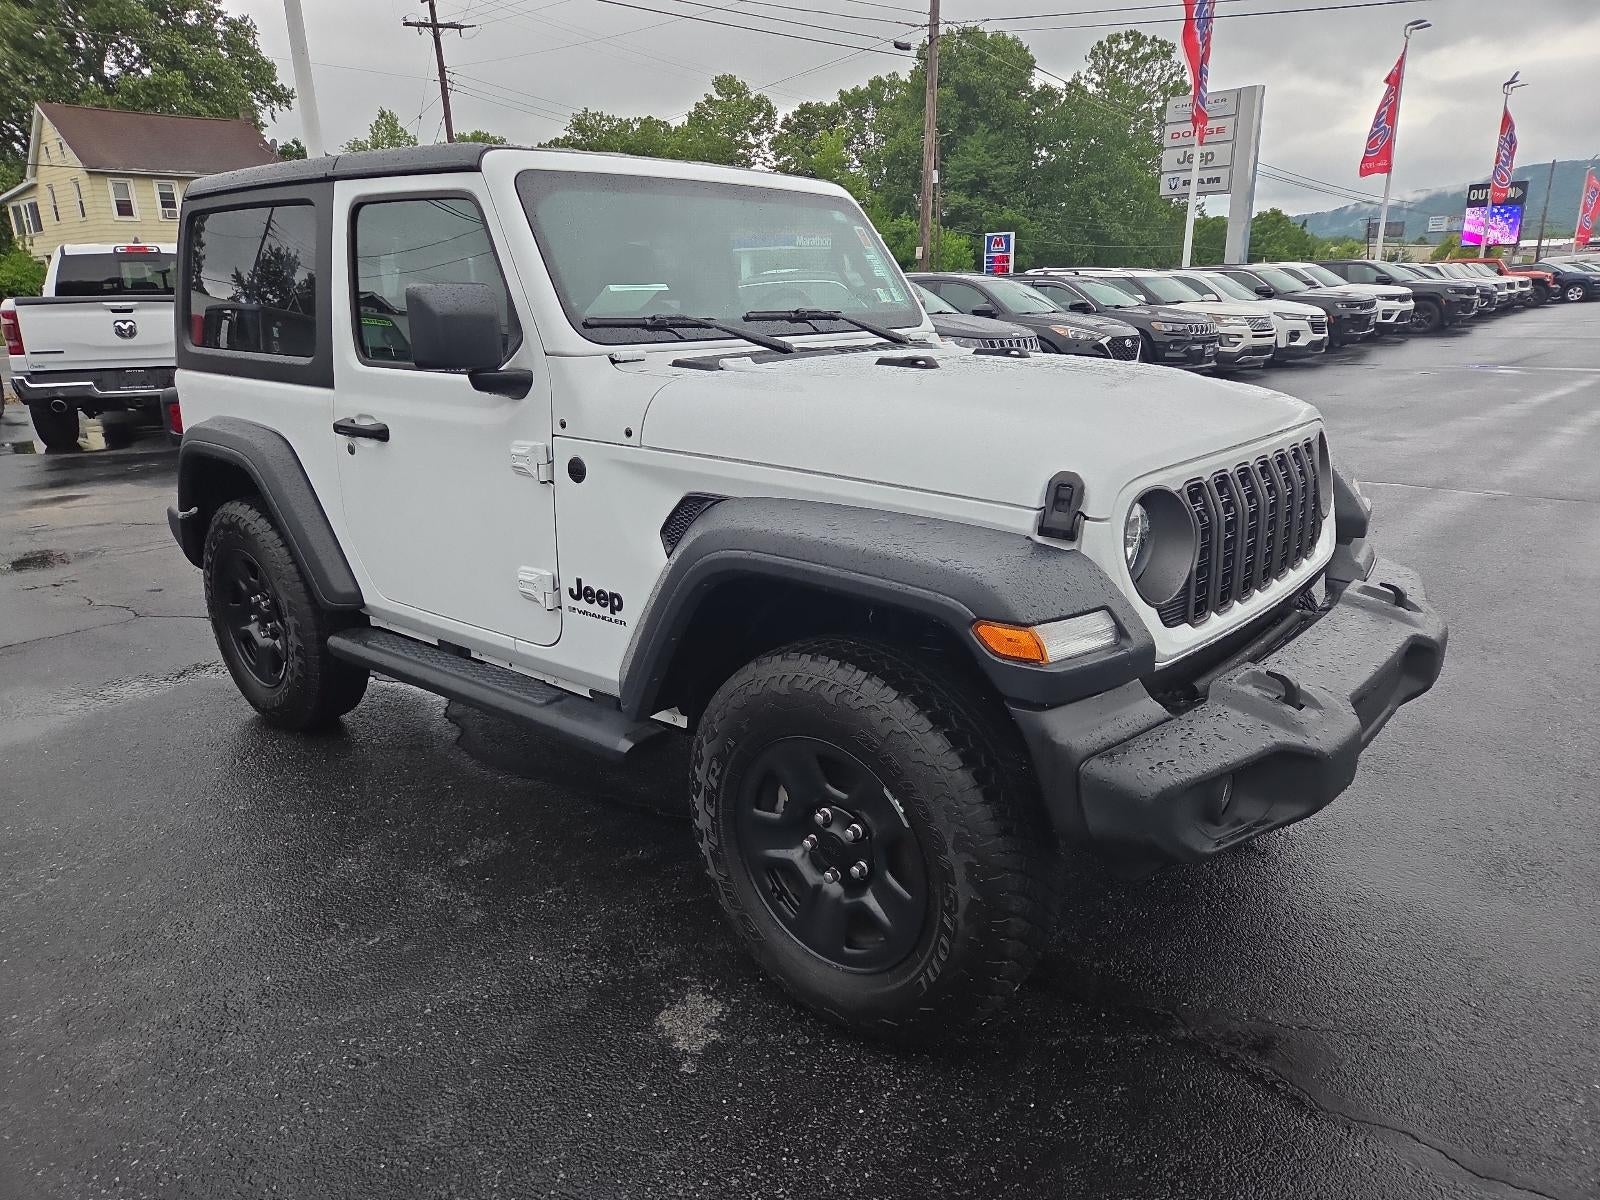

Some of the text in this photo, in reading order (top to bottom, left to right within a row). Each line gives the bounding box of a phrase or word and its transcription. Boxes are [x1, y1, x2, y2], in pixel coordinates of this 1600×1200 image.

[1174, 97, 1228, 109] CHRLER
[1176, 150, 1215, 165] Jeep
[1182, 176, 1221, 187] RAM
[1470, 187, 1516, 201] OUTN
[796, 235, 832, 248] Marathon
[568, 577, 624, 615] Jeep
[576, 607, 627, 627] WRANGLER
